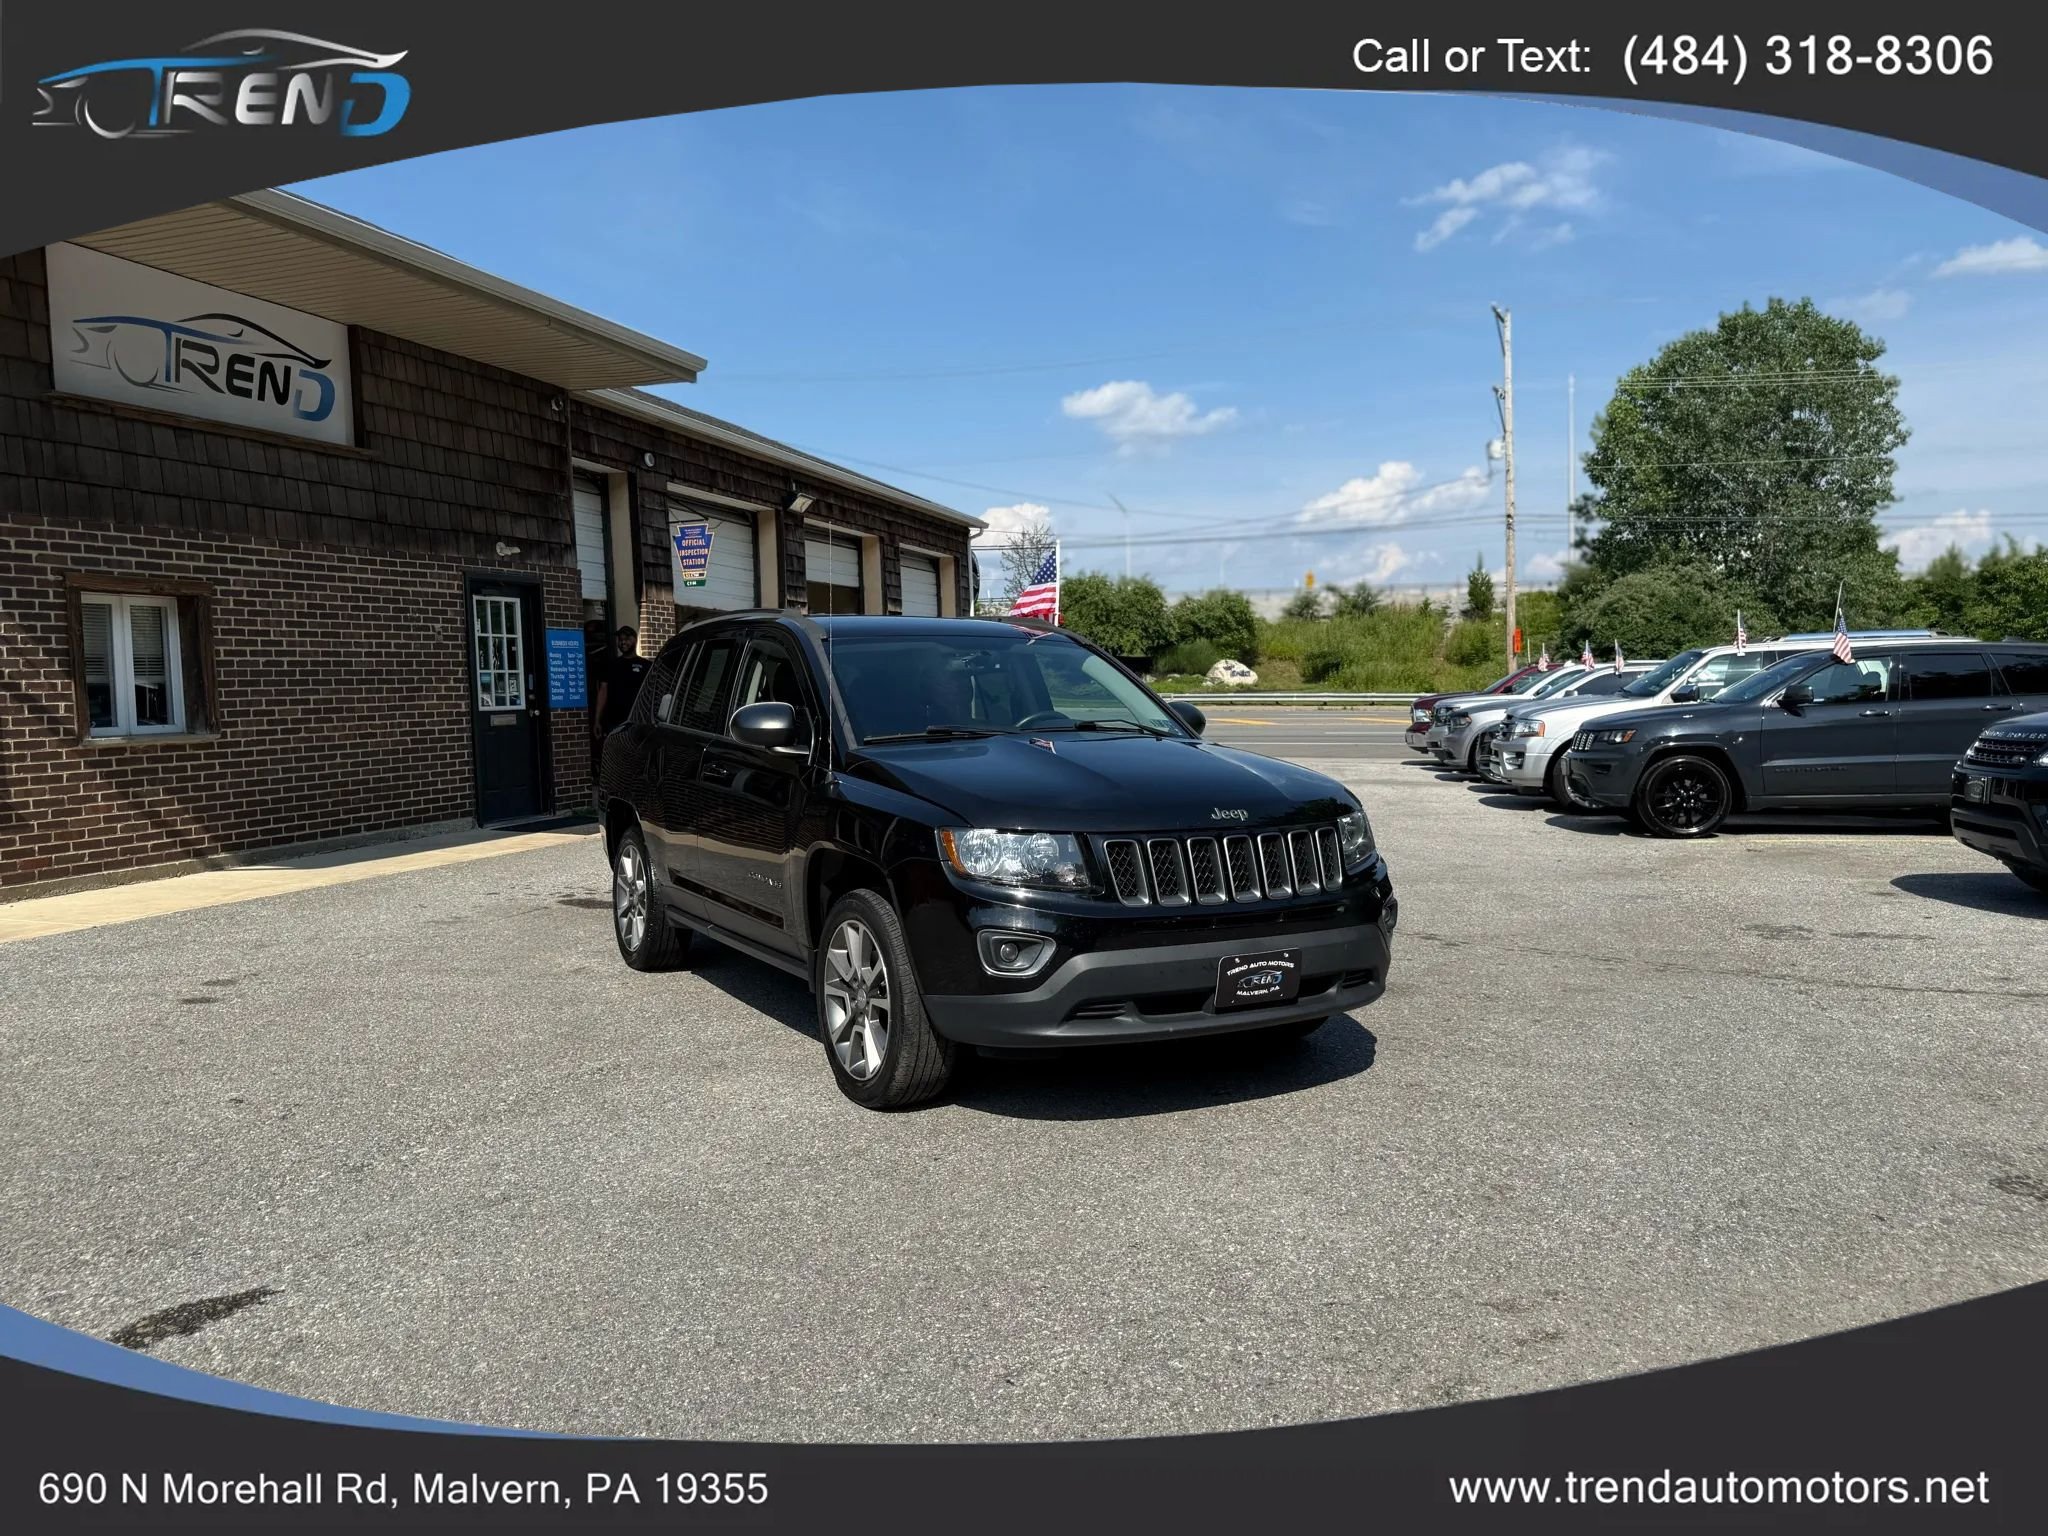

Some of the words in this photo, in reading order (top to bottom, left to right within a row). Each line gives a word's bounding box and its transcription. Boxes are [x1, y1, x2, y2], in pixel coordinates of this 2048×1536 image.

[131, 316, 336, 422] TREND
[682, 538, 706, 546] OFFICIAL
[679, 548, 708, 556] INSPECTION
[1211, 807, 1248, 821] Jeep
[1227, 964, 1248, 976] TREND
